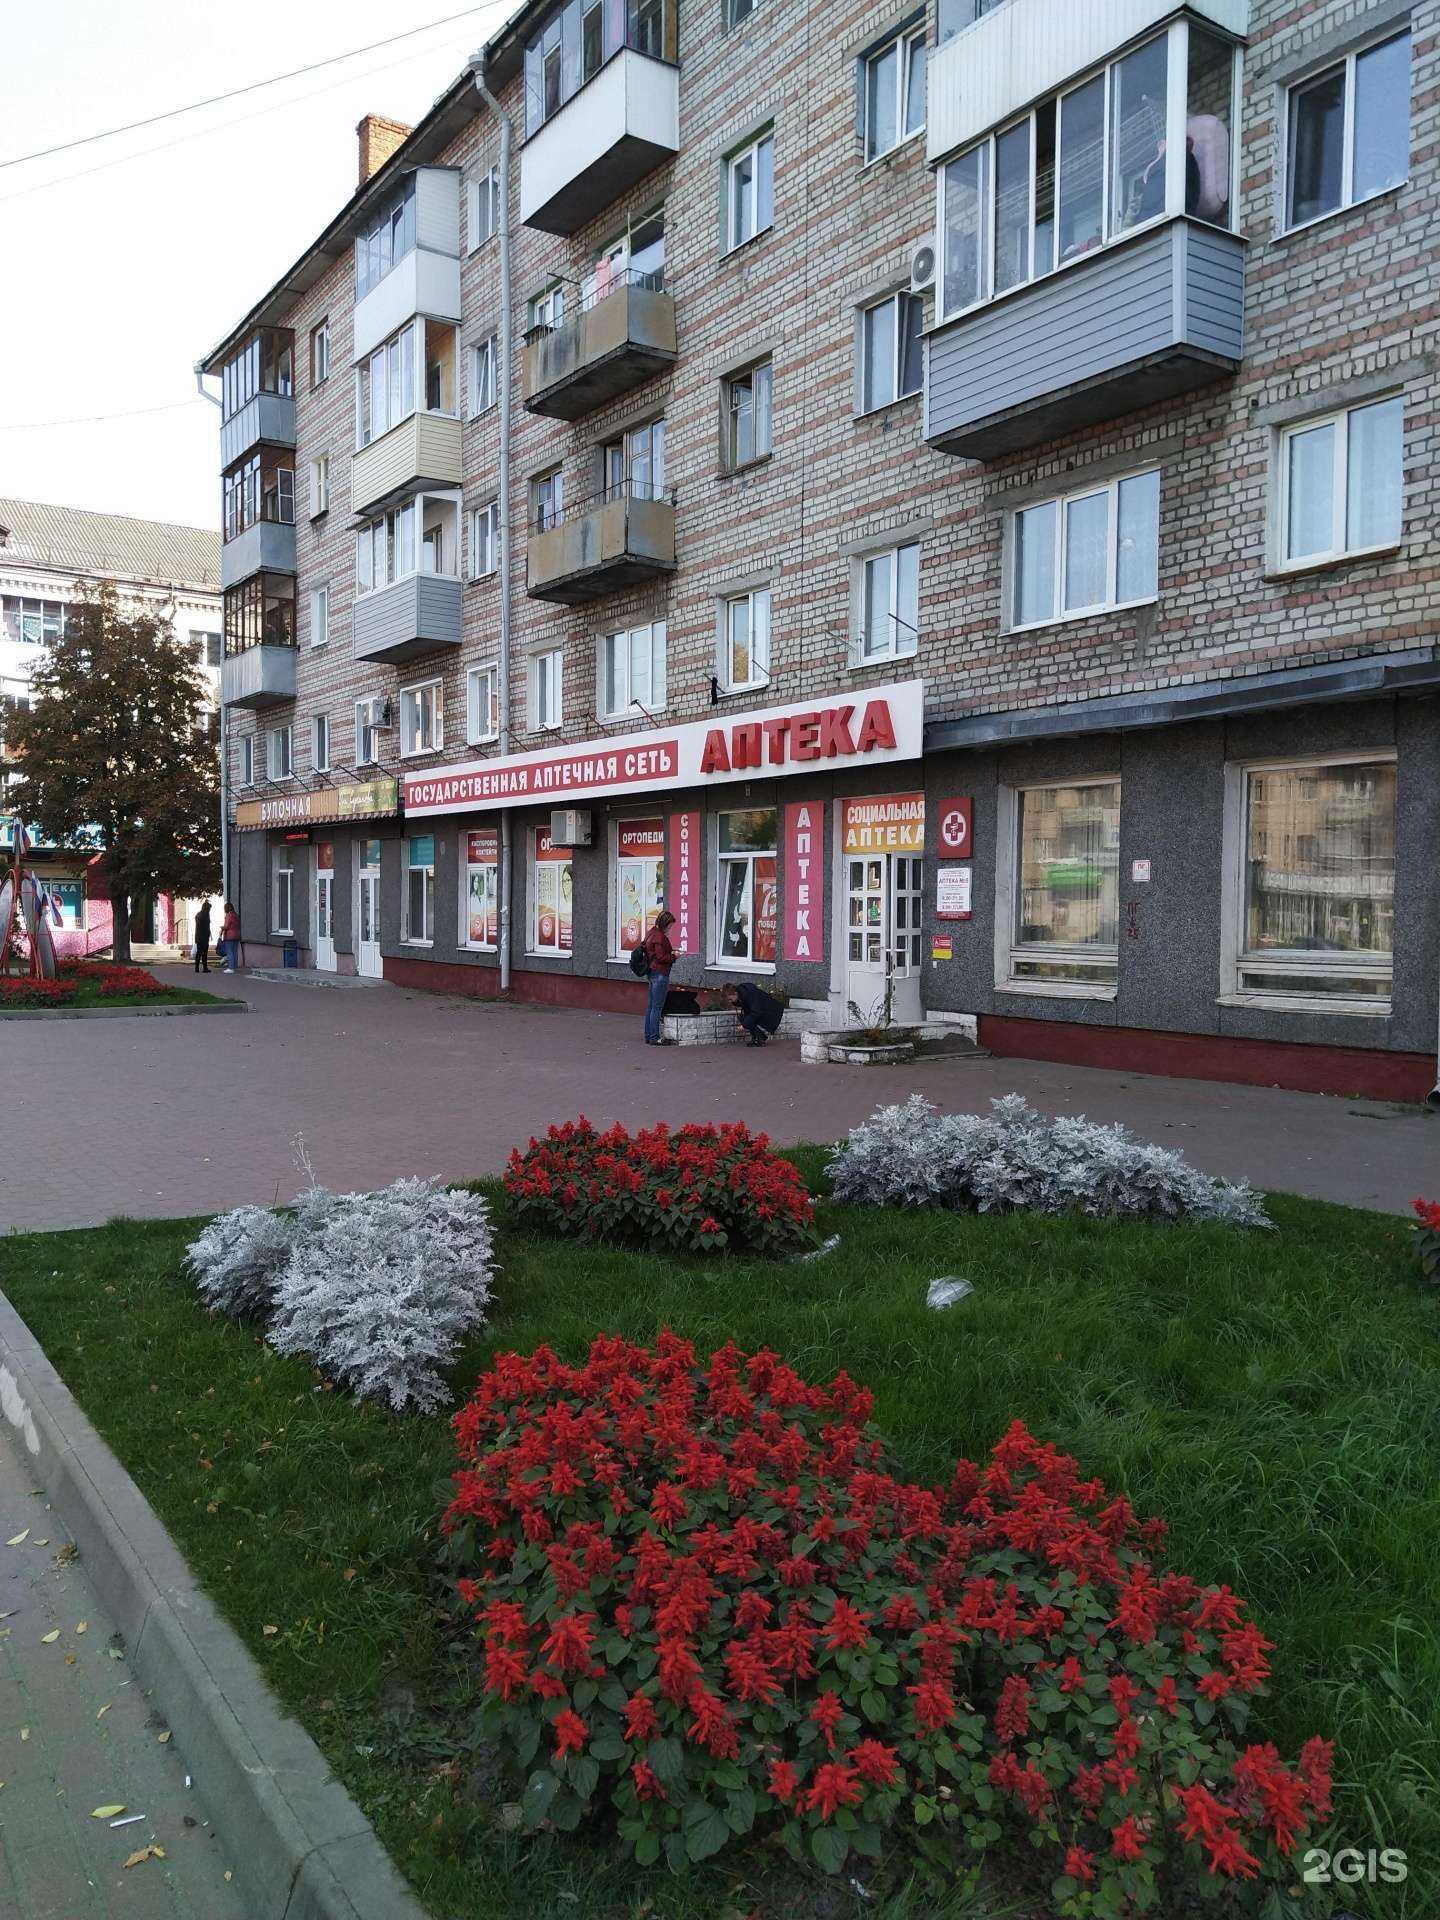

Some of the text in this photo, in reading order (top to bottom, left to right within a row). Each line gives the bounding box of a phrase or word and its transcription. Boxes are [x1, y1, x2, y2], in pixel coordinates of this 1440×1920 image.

[700, 700, 897, 773] АПТЕКА
[409, 774, 528, 805] ГОСУДАРСТВЕННАЯ
[533, 756, 617, 789] АПТЕЧНАЯ
[624, 749, 672, 777] СЕТЬ
[846, 825, 925, 847] АПТЕКА
[847, 801, 925, 826] СОЦИАЛЬНАЯ
[680, 814, 689, 952] СОЦИАЛЬНАЯ
[796, 808, 810, 956] АПТЕКА
